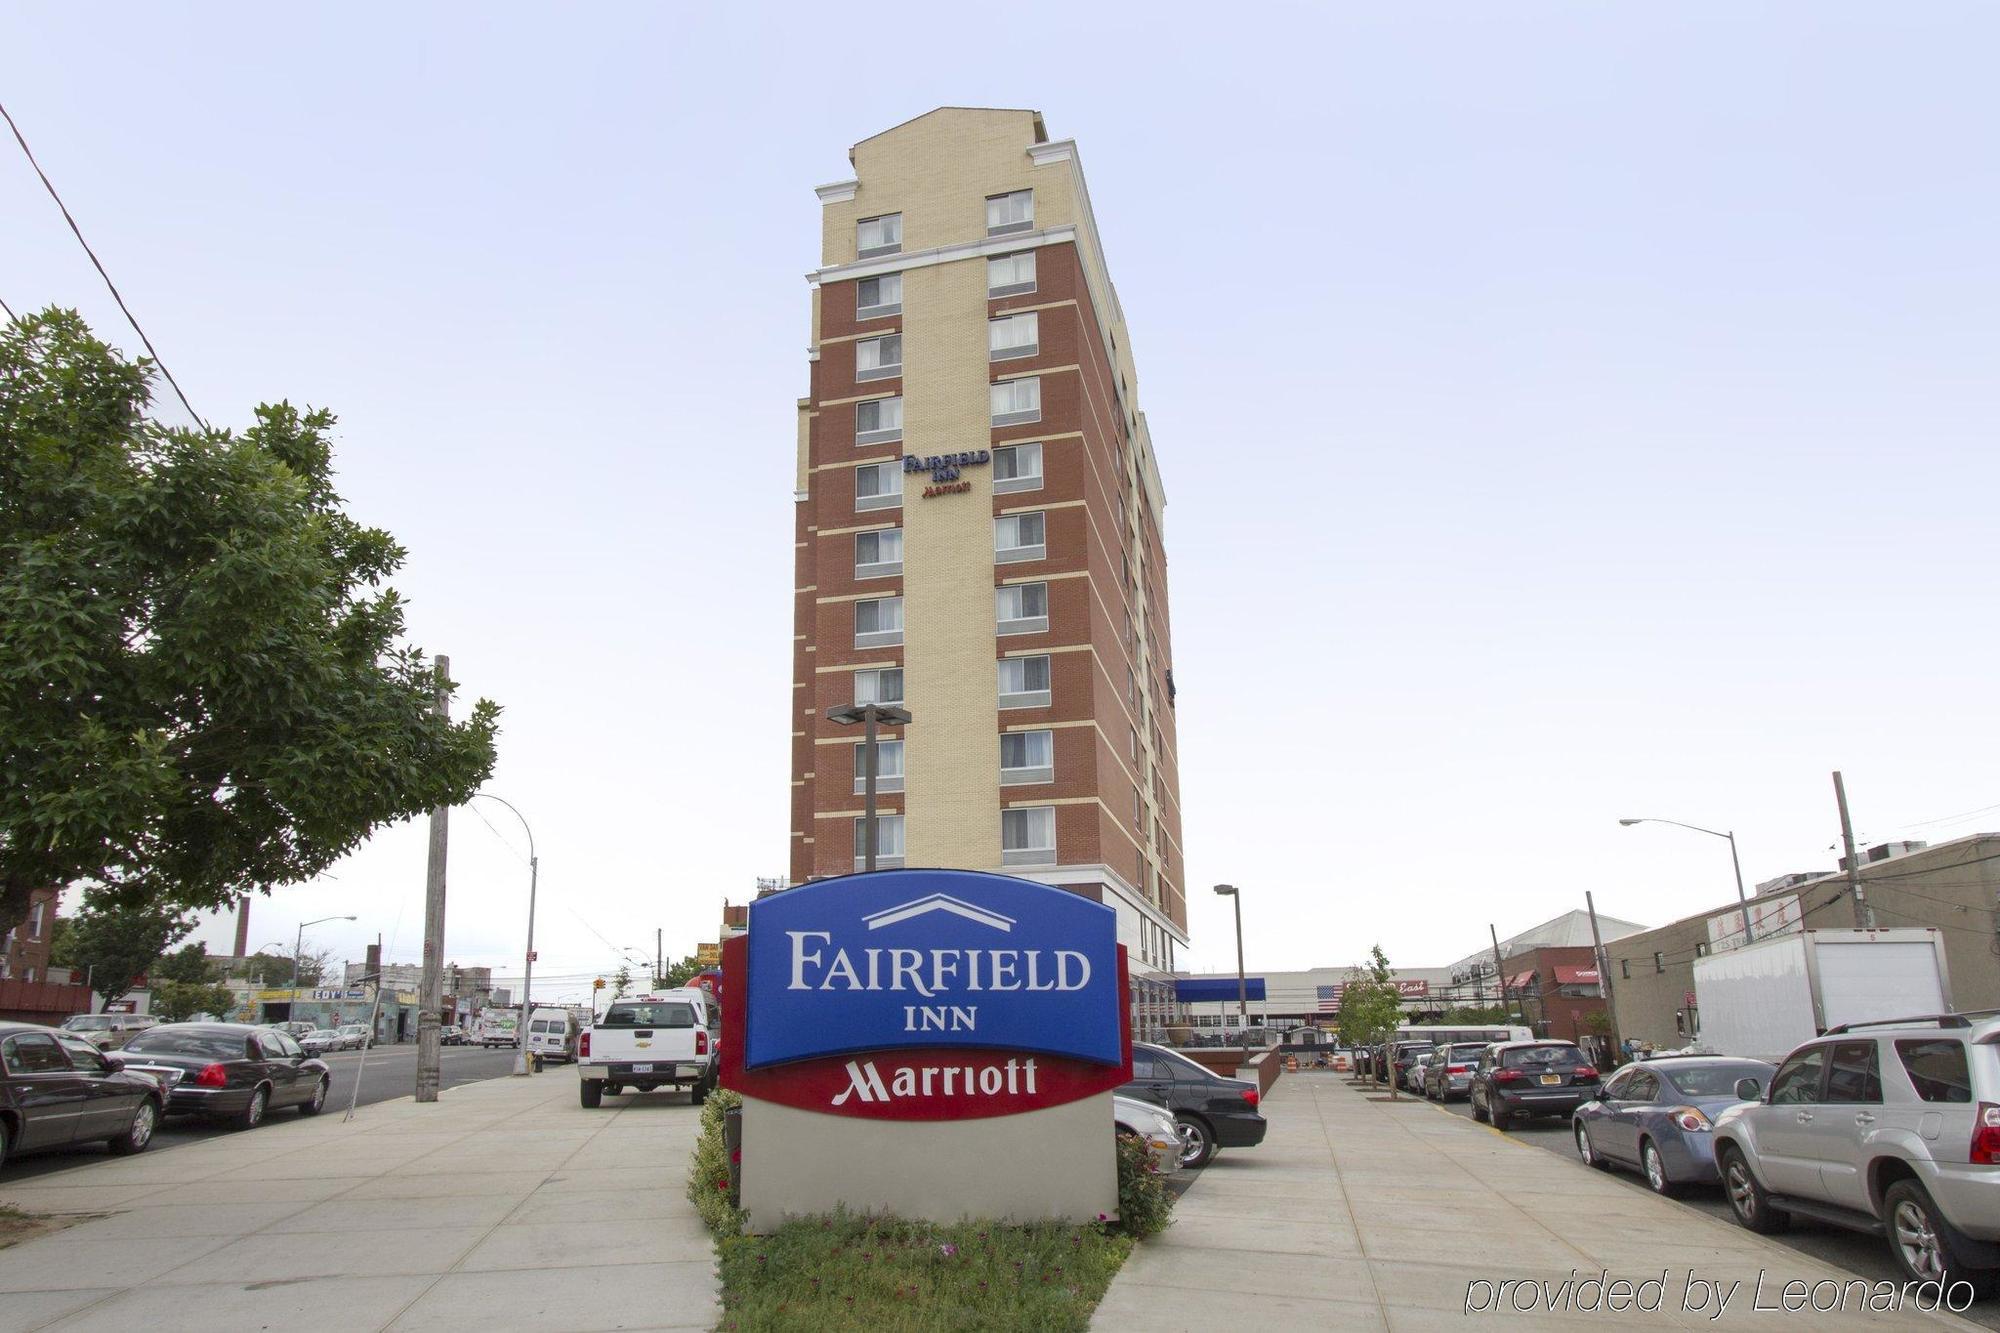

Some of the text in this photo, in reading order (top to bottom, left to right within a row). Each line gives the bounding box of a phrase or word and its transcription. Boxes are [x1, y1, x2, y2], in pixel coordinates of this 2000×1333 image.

[903, 450, 990, 473] FAIRFIELD
[932, 467, 960, 483] INN
[922, 481, 971, 499] Marriott
[785, 931, 1091, 997] FAIRFIELD
[1400, 981, 1425, 994] East
[903, 1006, 978, 1031] INN
[831, 1057, 1038, 1105] Marriott
